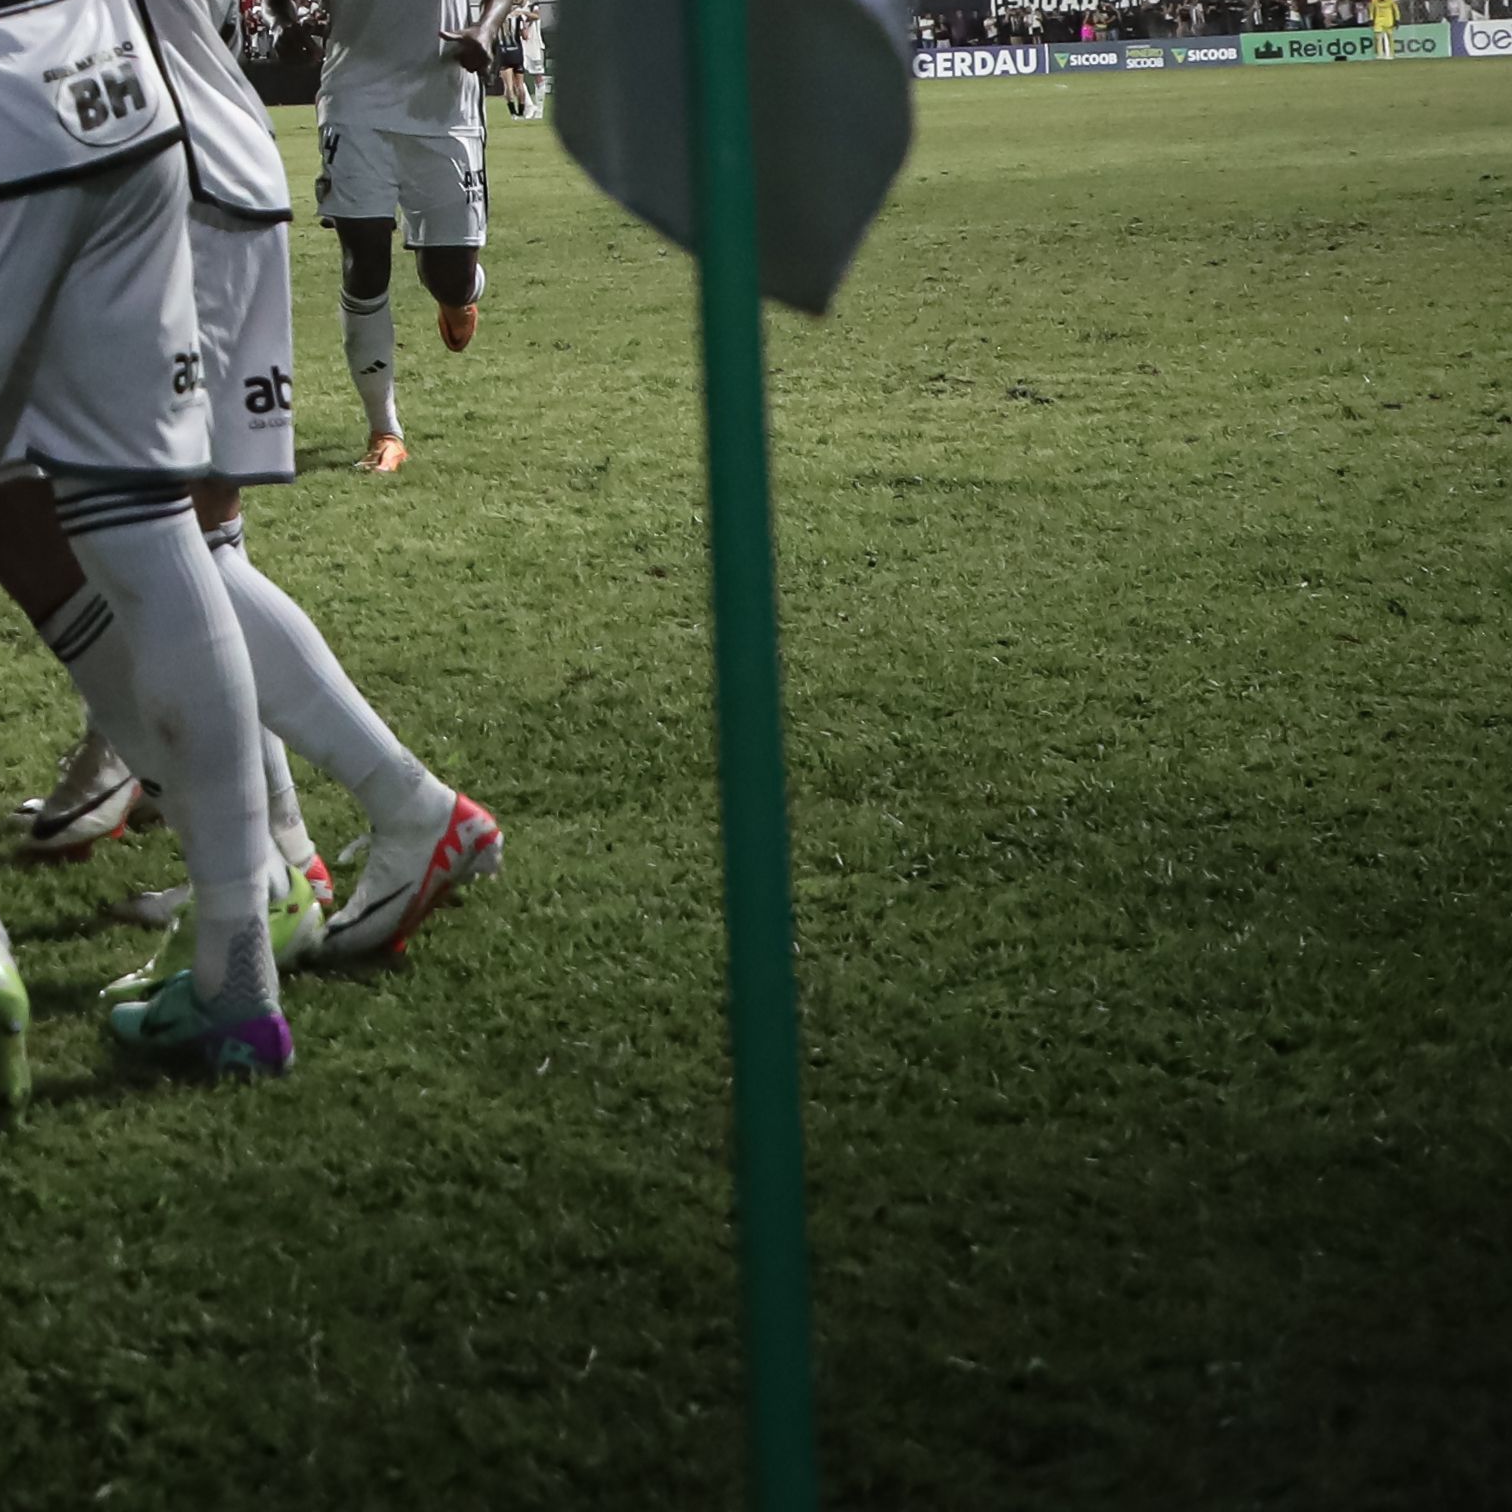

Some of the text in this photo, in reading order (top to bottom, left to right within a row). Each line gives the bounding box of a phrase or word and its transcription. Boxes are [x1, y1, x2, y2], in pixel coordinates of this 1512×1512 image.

[1069, 52, 1118, 67] SICOOB
[1187, 47, 1238, 62] SICOOB
[1290, 37, 1323, 58] Rei
[1327, 35, 1357, 56] do
[912, 48, 1038, 79] GERDAU
[67, 61, 147, 132] BH
[243, 365, 293, 414] ab
